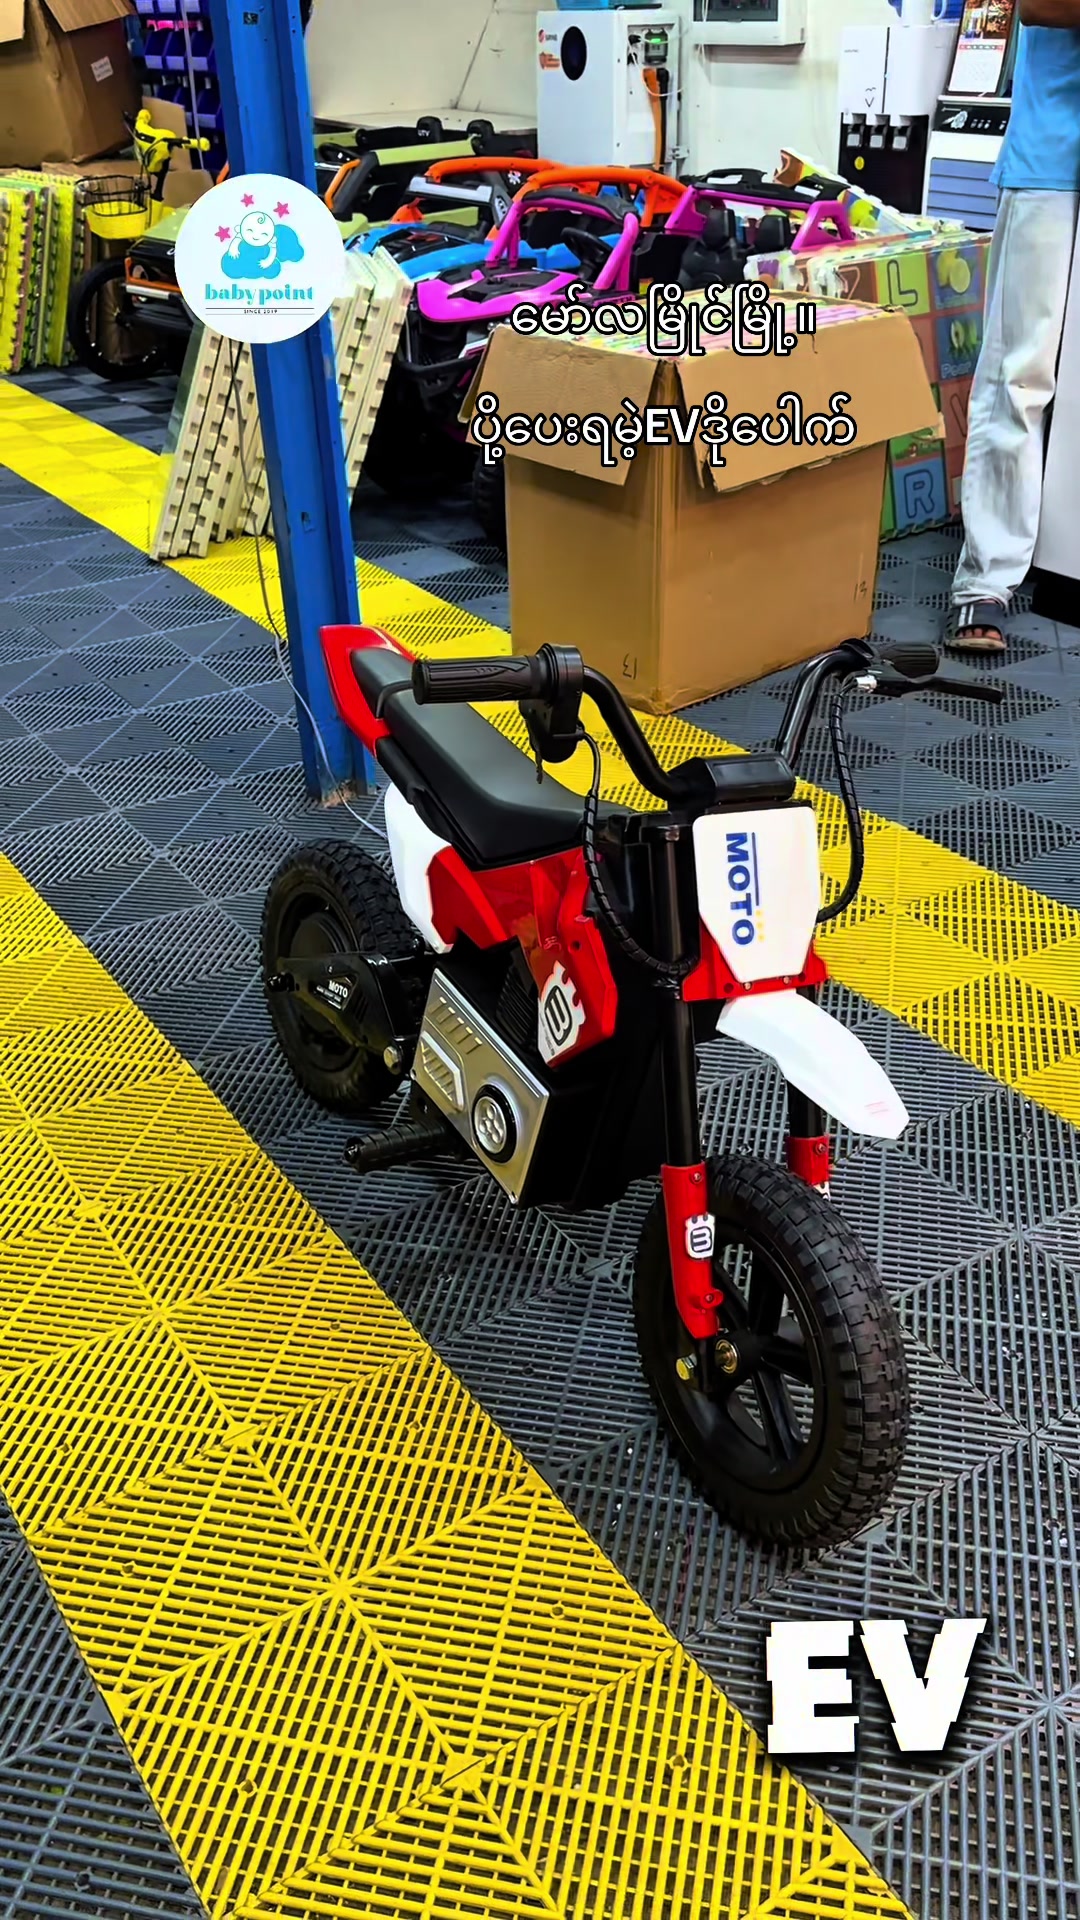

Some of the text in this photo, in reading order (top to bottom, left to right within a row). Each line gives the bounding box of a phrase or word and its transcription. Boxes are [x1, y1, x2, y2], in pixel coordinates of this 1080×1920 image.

[903, 468, 936, 519] R
[725, 832, 755, 945] MOTO
[328, 979, 349, 999] MOTO
